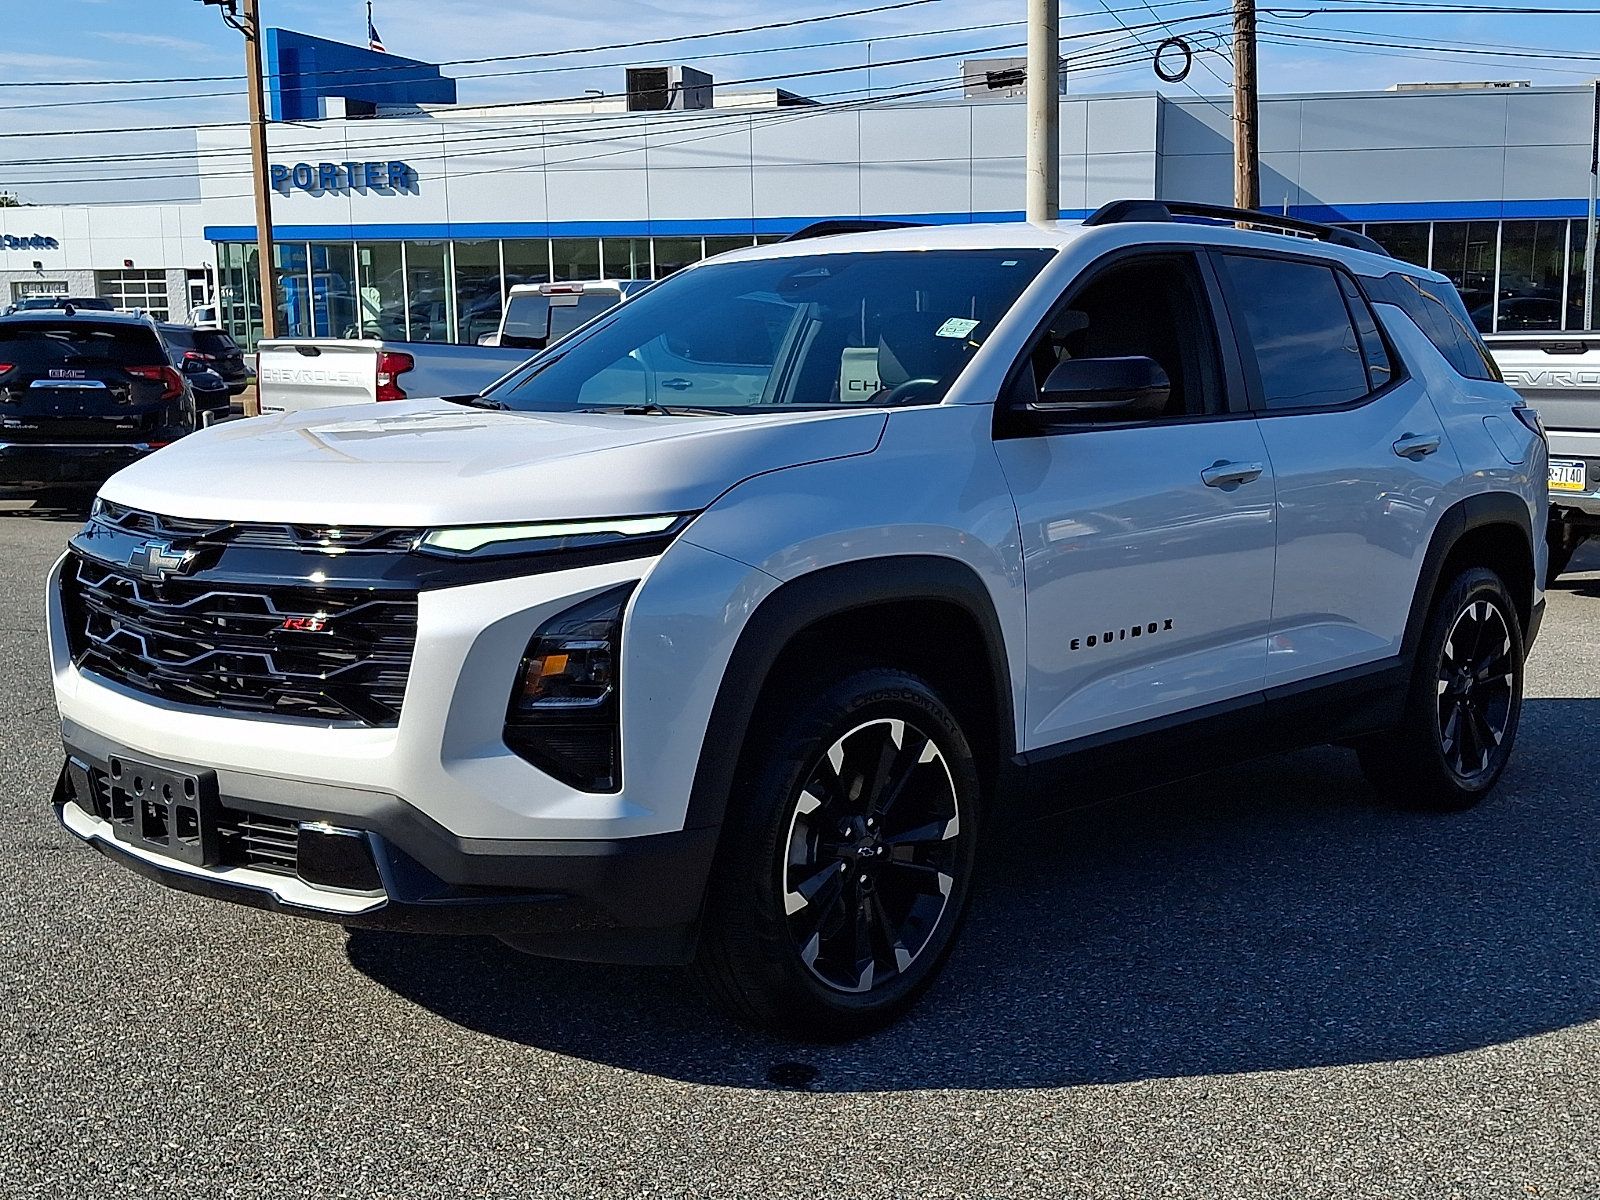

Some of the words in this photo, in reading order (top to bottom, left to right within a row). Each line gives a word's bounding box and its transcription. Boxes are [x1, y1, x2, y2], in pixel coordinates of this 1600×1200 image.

[271, 160, 411, 190] PORTER
[23, 284, 66, 293] SERVICE
[49, 369, 85, 378] GMC
[283, 617, 326, 630] RS
[1070, 619, 1172, 650] EQUINOX
